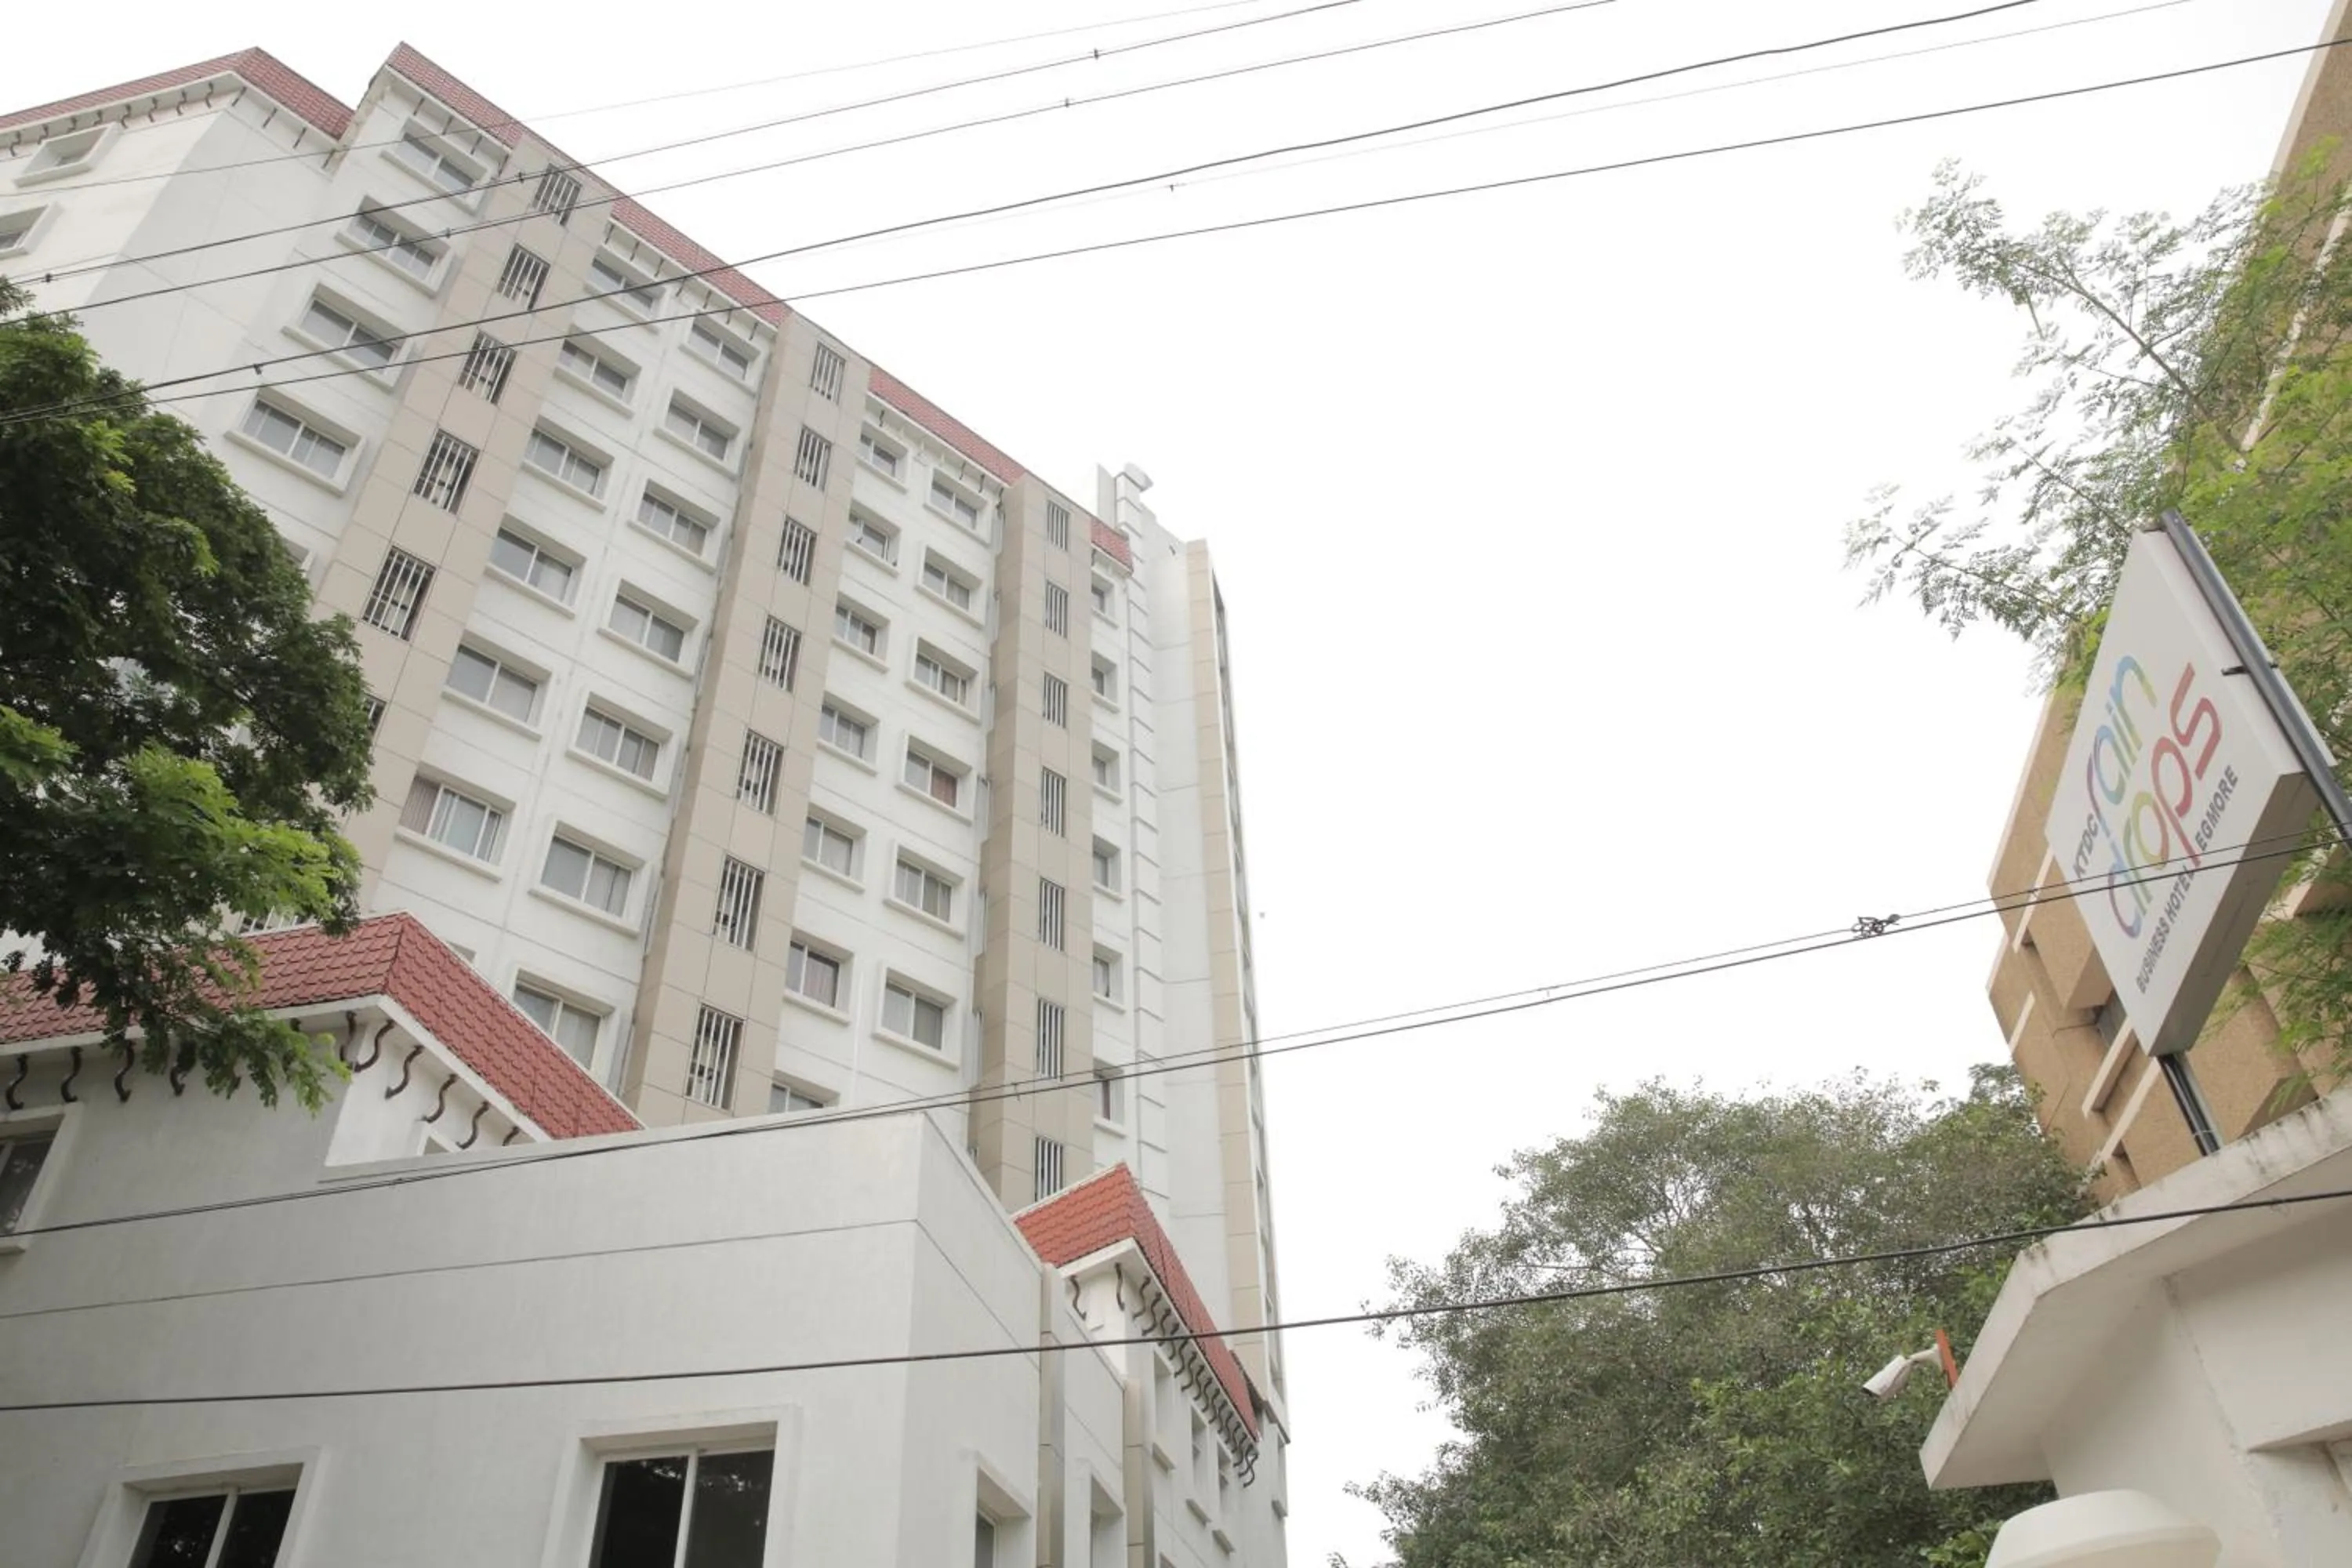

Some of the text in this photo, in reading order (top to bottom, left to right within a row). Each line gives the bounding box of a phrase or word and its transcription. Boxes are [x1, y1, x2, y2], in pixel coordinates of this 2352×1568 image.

[2072, 813, 2099, 879] KTDC
[2086, 655, 2158, 838] rain
[2107, 662, 2223, 938] drops
[2136, 765, 2239, 994] BUSINESS HOTEL EGMORE
